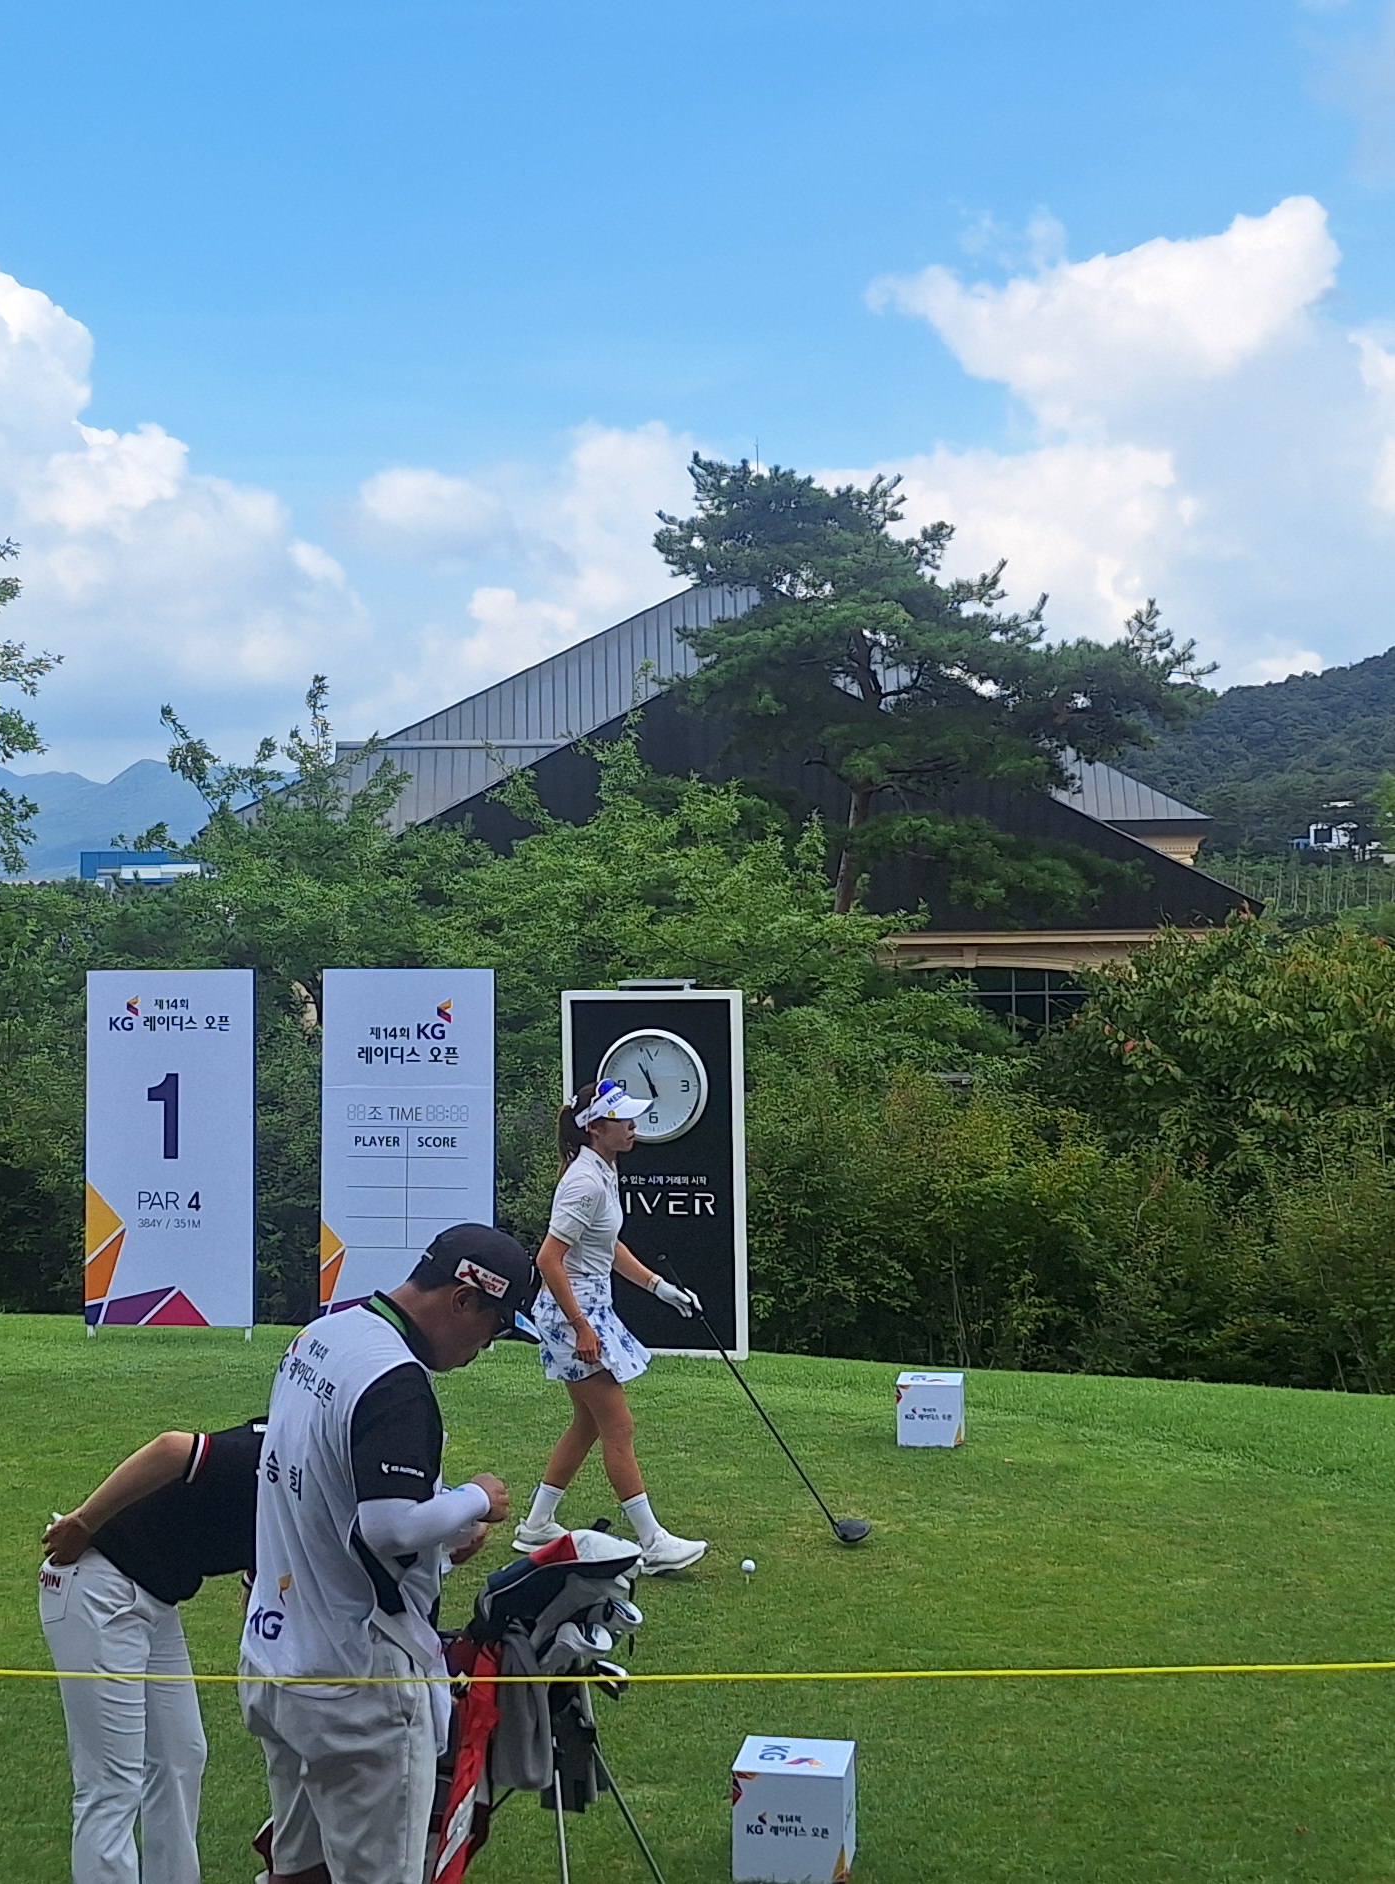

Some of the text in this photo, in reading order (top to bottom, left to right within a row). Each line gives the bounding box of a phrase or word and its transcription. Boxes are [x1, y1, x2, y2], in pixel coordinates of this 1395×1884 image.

[153, 998, 189, 1010] 제14회
[108, 1015, 231, 1032] KG 레이디스 오픈
[369, 1023, 446, 1040] 제14회 KG
[357, 1046, 460, 1065] 레이디스 오픈
[680, 1080, 690, 1092] 3
[147, 1072, 179, 1159] 1
[387, 1106, 423, 1121] TIME
[649, 1111, 659, 1124] 6
[354, 1135, 458, 1148] PLAYER SCORE
[137, 1190, 201, 1211] PAR 4
[137, 1218, 163, 1229] 384Y
[173, 1218, 201, 1229] 351M
[290, 1356, 319, 1391] 레이디스
[313, 1378, 336, 1408] 오픈
[758, 1744, 791, 1761] KG
[746, 1824, 764, 1835] KG
